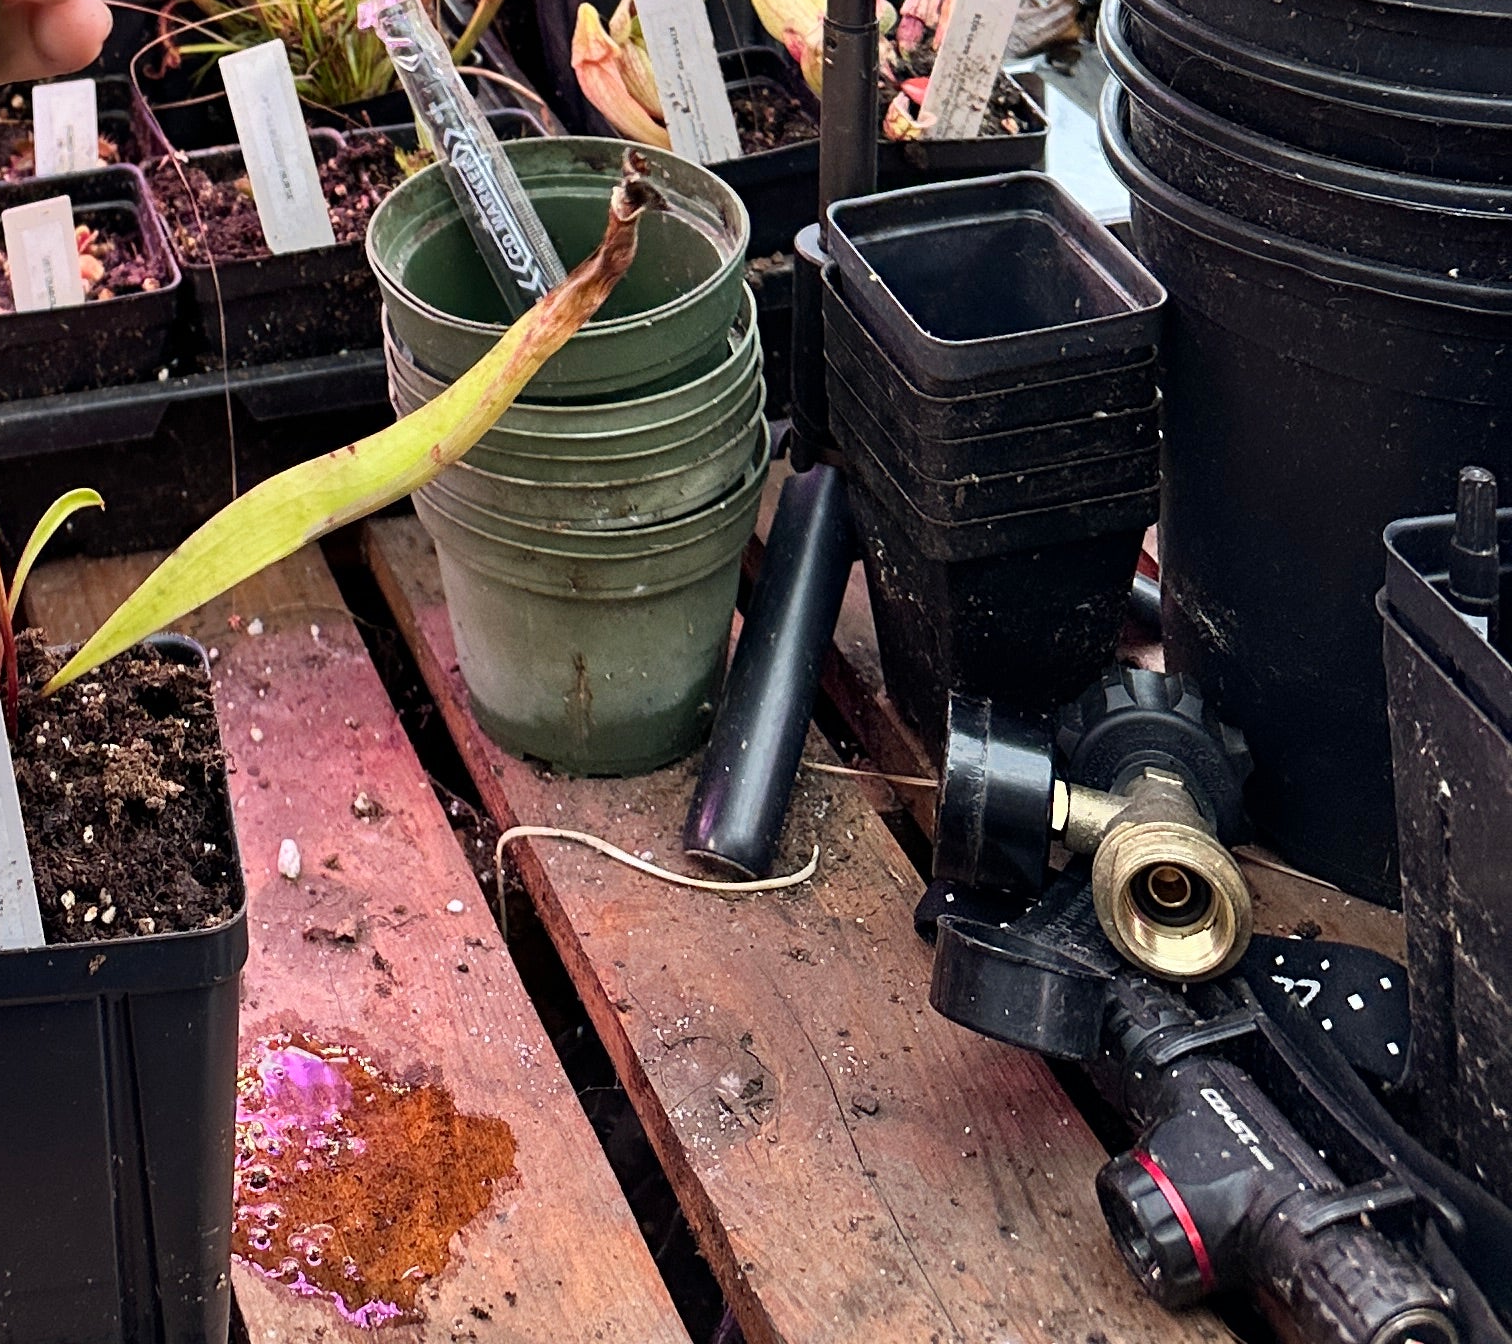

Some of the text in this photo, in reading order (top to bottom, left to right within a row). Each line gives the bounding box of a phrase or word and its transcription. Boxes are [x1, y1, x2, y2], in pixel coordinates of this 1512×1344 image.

[460, 150, 523, 260] CD MARKER
[1200, 1088, 1260, 1145] COAST
